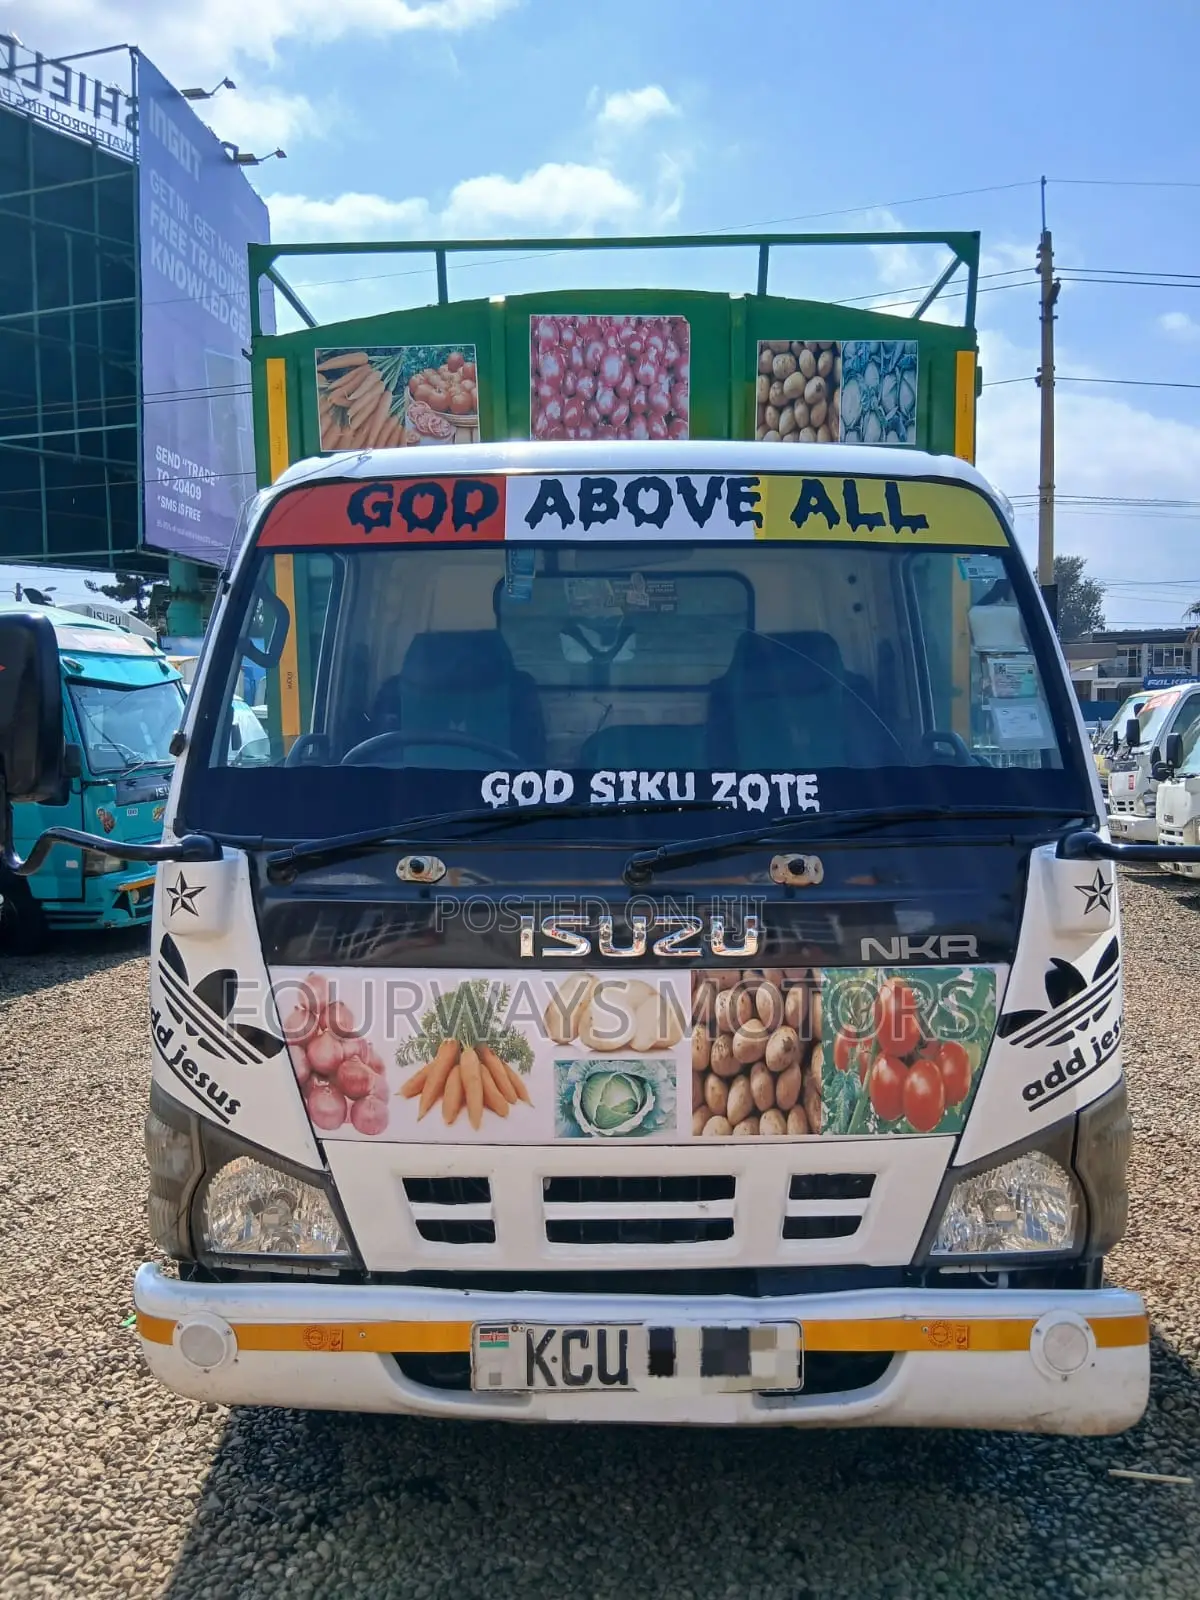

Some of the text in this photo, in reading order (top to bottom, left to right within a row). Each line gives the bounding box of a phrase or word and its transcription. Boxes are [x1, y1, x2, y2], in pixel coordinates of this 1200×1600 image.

[150, 169, 176, 208] GET
[194, 216, 217, 246] GET
[218, 236, 247, 281] MORE
[150, 200, 249, 310] FREE TRADING
[155, 445, 181, 469] SEND
[156, 467, 202, 500] TO 20409
[347, 476, 929, 535] GOD ABOVE ALL
[185, 506, 201, 522] FREE
[481, 769, 820, 814] GOD SIKU ZOTE
[520, 916, 758, 957] ISUZU
[860, 934, 979, 961] NKR
[168, 1044, 241, 1115] jesus
[1022, 1047, 1086, 1101] add
[526, 1328, 628, 1387] KCU
